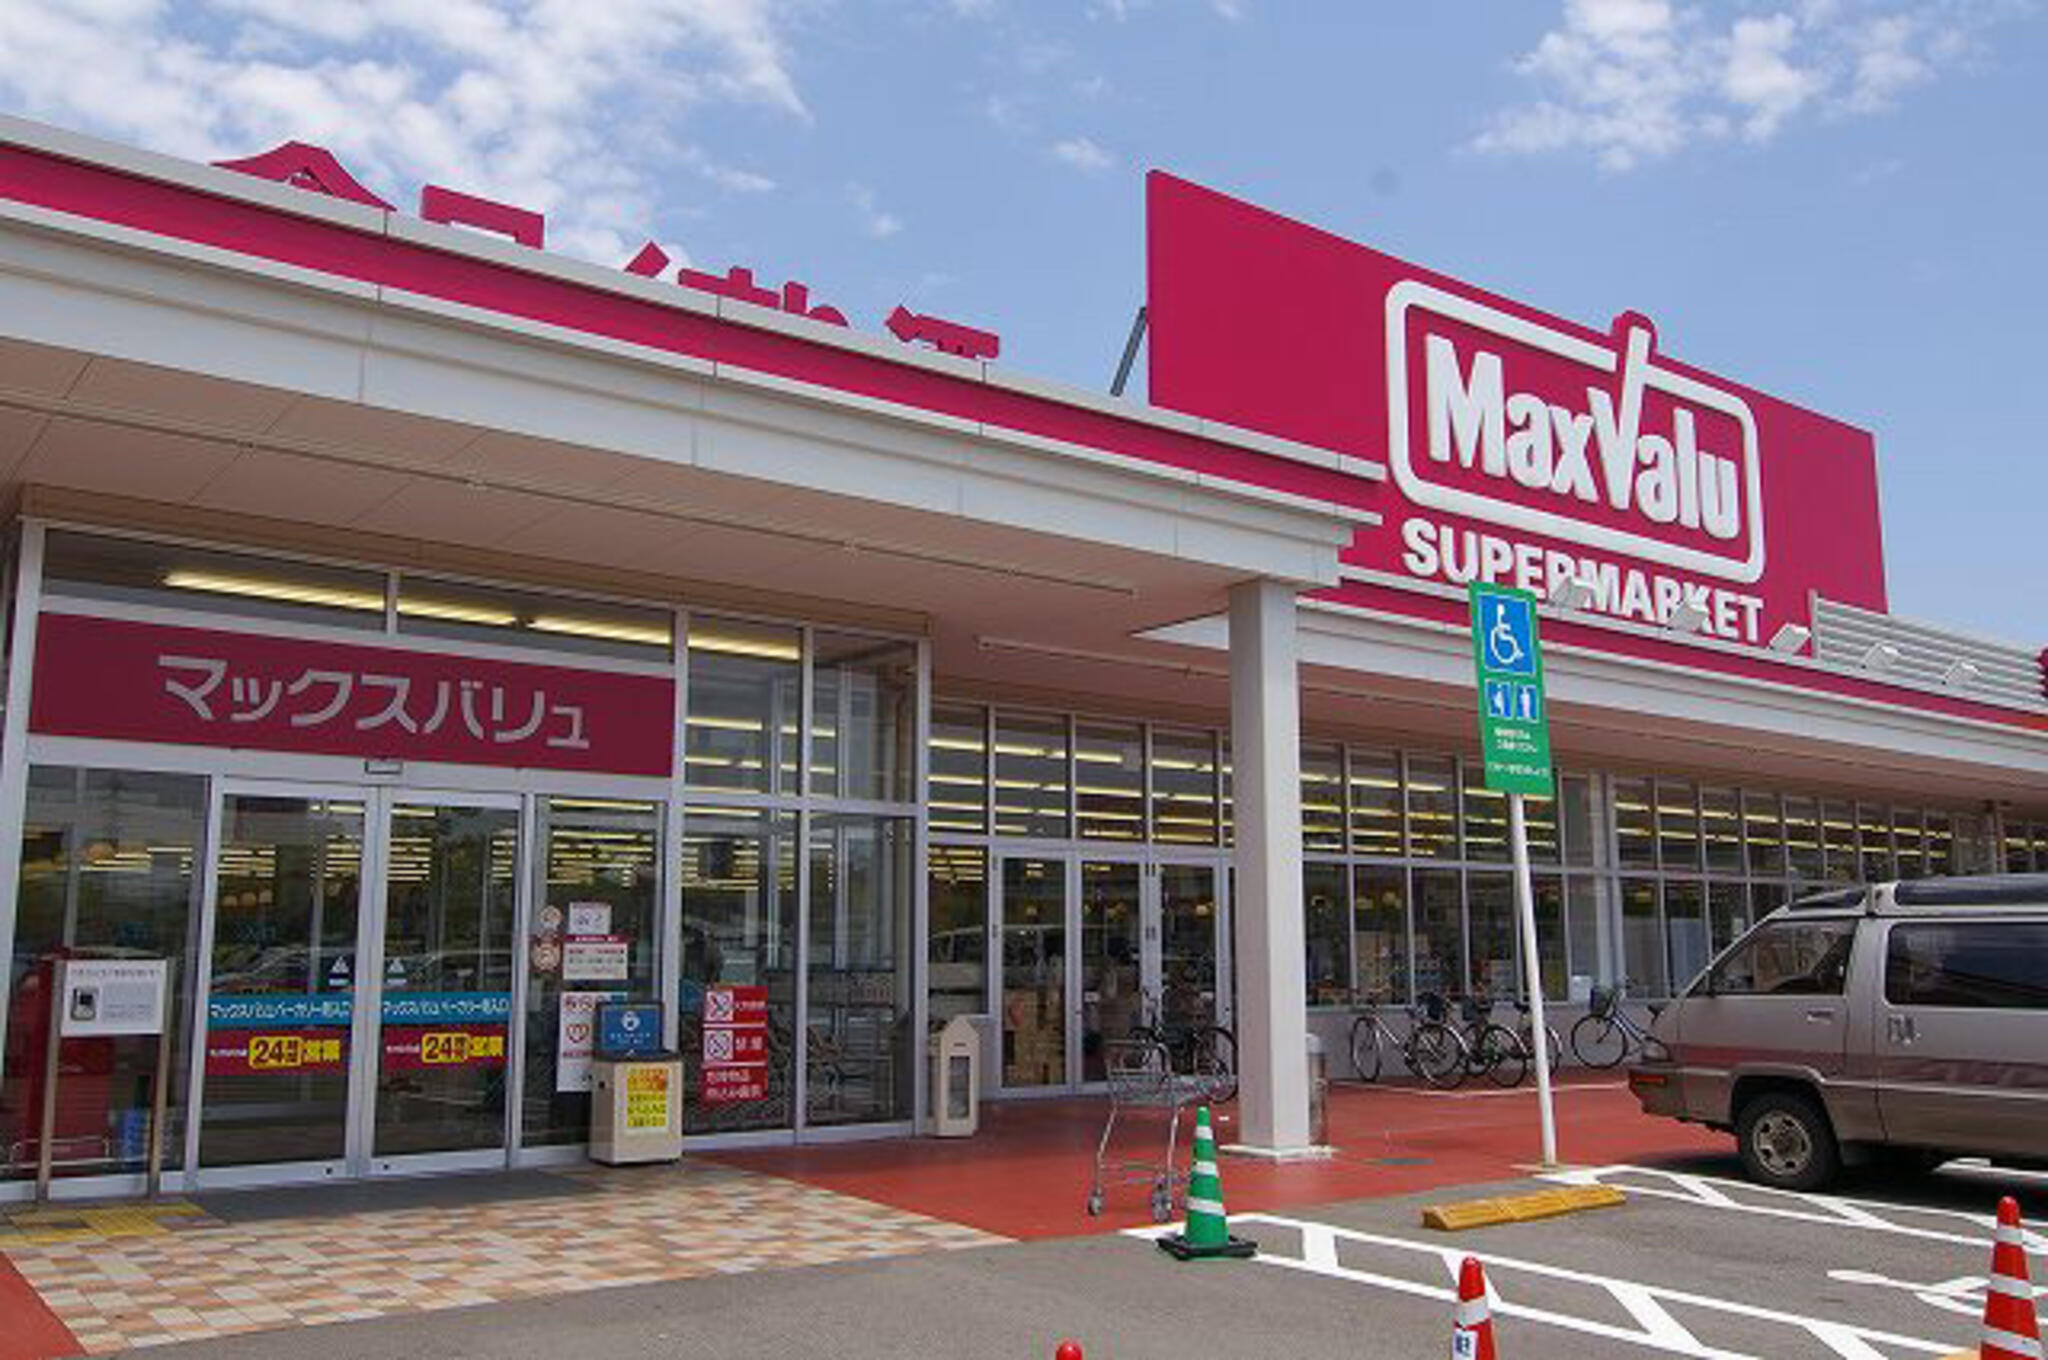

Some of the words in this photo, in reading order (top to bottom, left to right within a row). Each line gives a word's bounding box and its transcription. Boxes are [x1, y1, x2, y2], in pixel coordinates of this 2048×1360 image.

[1426, 326, 1741, 540] MaxValu
[1402, 517, 1764, 643] SUPERMARKET
[158, 654, 591, 749] マックスバリュ
